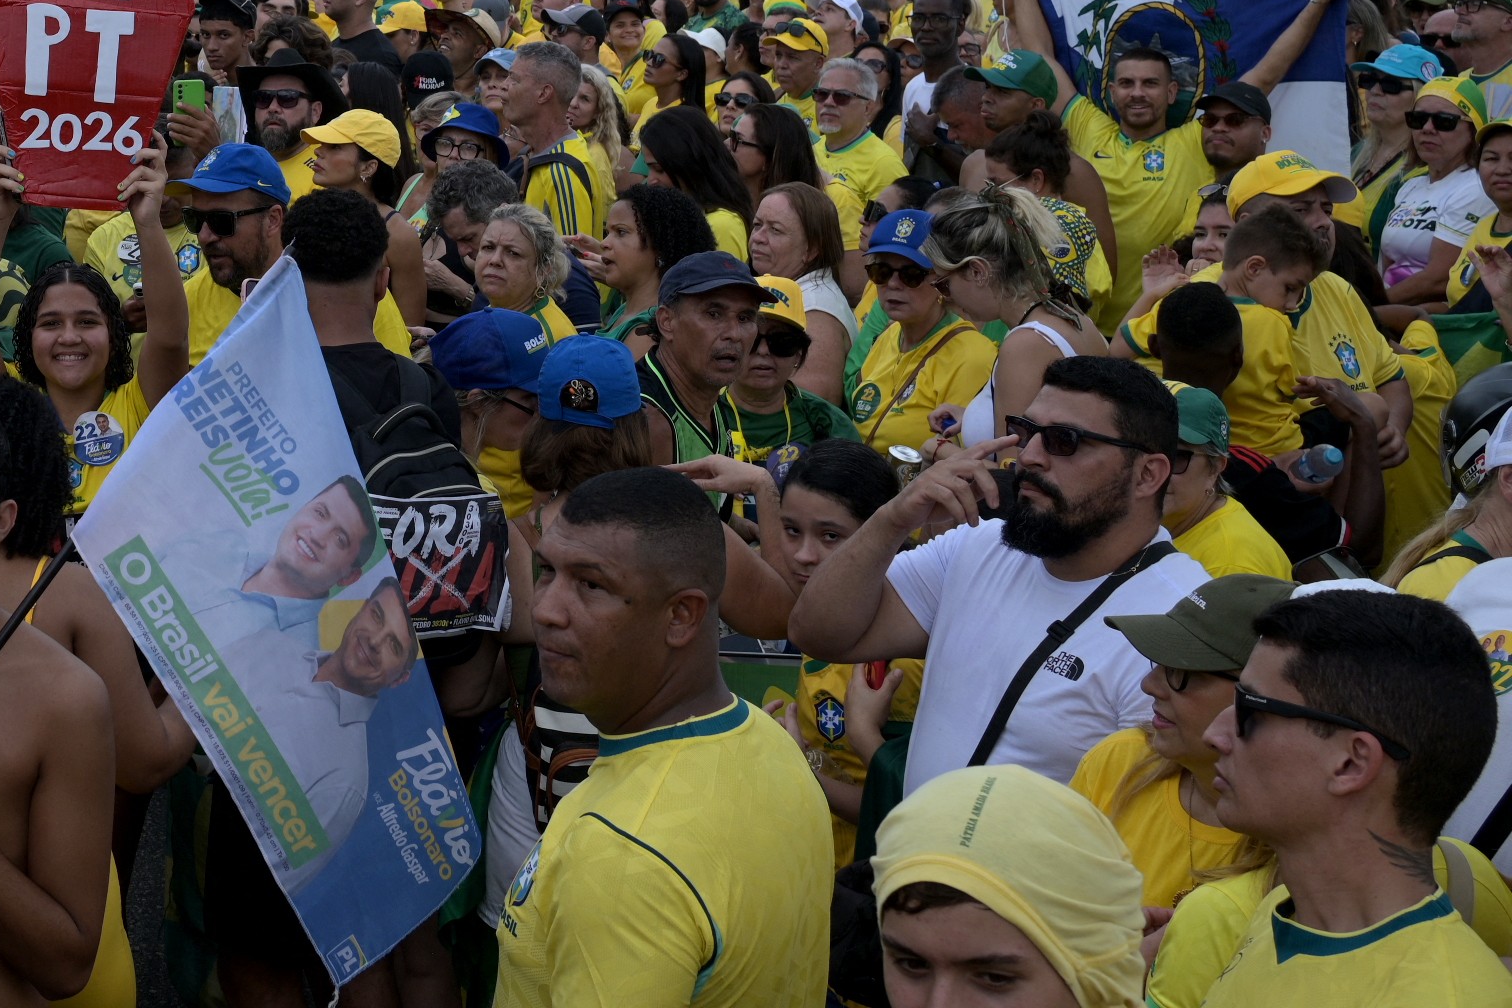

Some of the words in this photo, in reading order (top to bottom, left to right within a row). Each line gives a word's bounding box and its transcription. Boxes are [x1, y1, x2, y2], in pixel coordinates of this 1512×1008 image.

[23, 2, 135, 104] PT
[19, 107, 143, 155] 2026
[225, 360, 297, 455] PREFEITO
[860, 388, 875, 402] 22
[1349, 382, 1369, 392] RASIL
[75, 423, 98, 441] 22
[170, 376, 231, 449] REIS
[192, 357, 300, 496] NETINHO
[776, 446, 800, 463] 22
[1043, 664, 1069, 678] FACE
[1046, 656, 1074, 670] ORTH
[1058, 651, 1076, 662] THE
[119, 552, 152, 585] O
[139, 584, 220, 685] Brasil
[202, 680, 255, 740] vai
[237, 736, 317, 854] vencer
[396, 728, 474, 867] Flávio
[960, 817, 979, 848] PÁTRIA
[971, 794, 989, 820] AMADA
[377, 803, 408, 848] Alfredo
[400, 843, 430, 884] Gaspar
[388, 768, 453, 881] Bolsonaro
[501, 906, 518, 939] ASIL
[337, 946, 358, 976] PL
